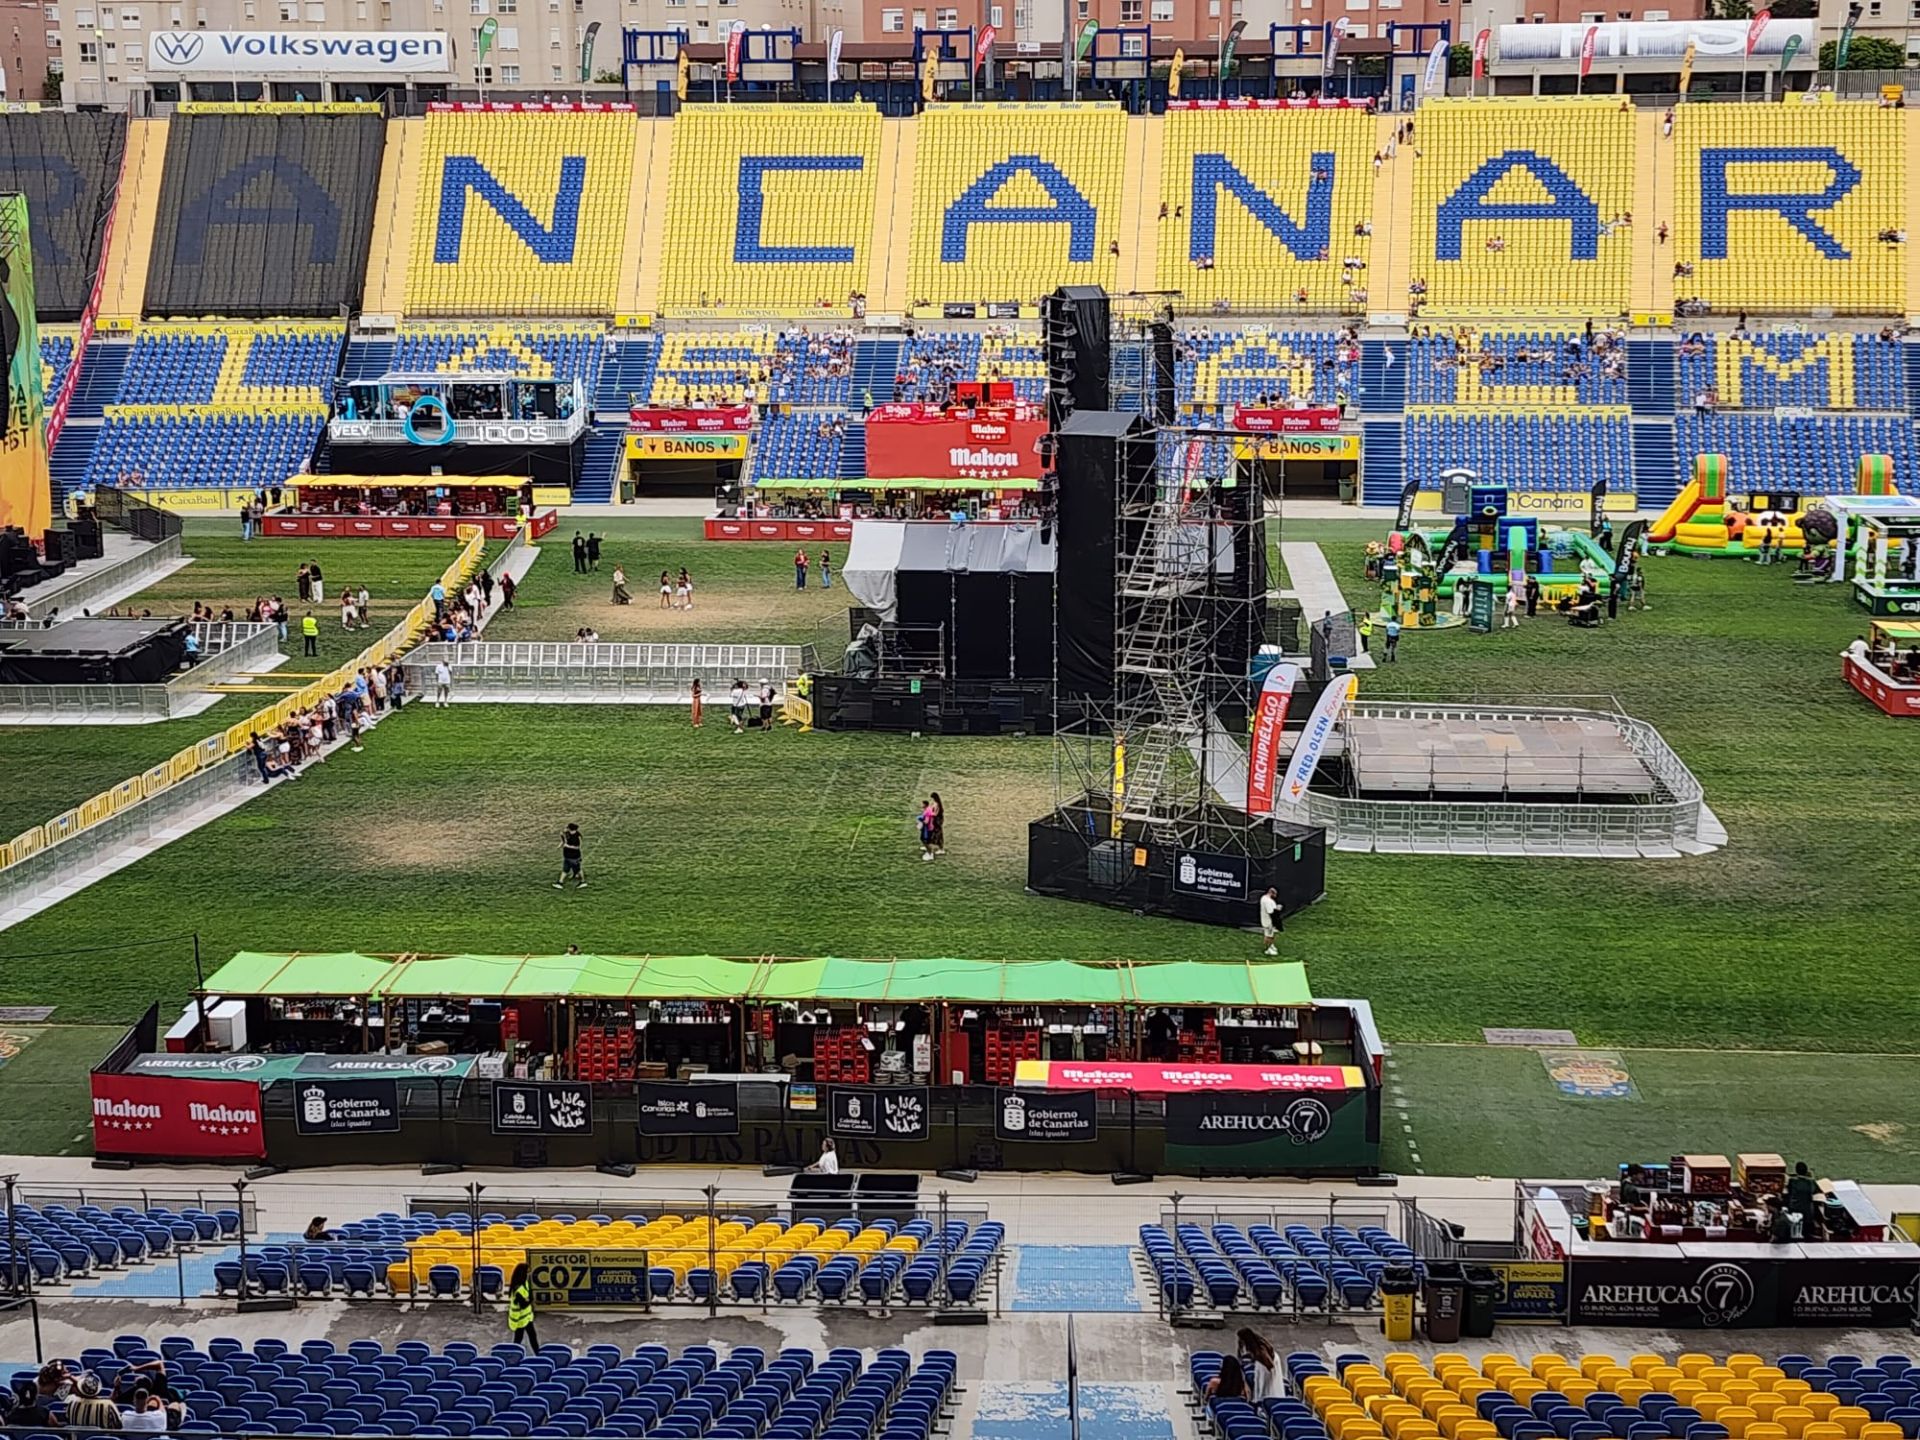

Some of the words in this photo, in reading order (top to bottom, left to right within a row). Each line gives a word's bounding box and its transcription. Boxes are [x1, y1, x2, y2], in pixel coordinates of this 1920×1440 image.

[219, 34, 442, 62] Volkswagen
[402, 323, 426, 331] HPS
[435, 323, 459, 331] HPS
[470, 323, 494, 331] HPS
[507, 323, 531, 331] HPS
[539, 323, 564, 331] HPS
[574, 323, 598, 331] HPS
[333, 426, 369, 436] VEEV
[479, 426, 548, 442] IQOS
[971, 423, 1006, 434] Mahou
[664, 437, 715, 453] BAÑOS
[949, 448, 1018, 467] Mahou
[169, 495, 218, 505] CaixaBank
[1518, 494, 1584, 508] Canaria
[1400, 495, 1414, 526] Bounty
[1619, 537, 1637, 572] Bounty
[1276, 695, 1289, 725] renting
[1253, 695, 1278, 792] ARCHIPIÉLAGO
[1197, 868, 1234, 879] Gobierno
[1207, 877, 1241, 887] Canarias
[139, 1059, 225, 1069] AREHUCAS
[330, 1061, 418, 1070] AREHUCAS
[1062, 1068, 1133, 1081] Mahou
[1161, 1070, 1232, 1082] Mahou
[1260, 1071, 1333, 1084] Mahou
[93, 1097, 161, 1118] Mahou
[329, 1099, 379, 1109] Gobierno
[189, 1103, 257, 1123] Mahou
[329, 1109, 343, 1118] de
[346, 1109, 391, 1118] Canarias
[1028, 1109, 1079, 1119] Gobierno
[550, 1111, 585, 1128] Vida
[885, 1116, 921, 1132] Vida
[1028, 1119, 1040, 1128] de
[1043, 1119, 1089, 1129] Canarias
[1199, 1114, 1291, 1130] AREHUCAS
[1299, 1111, 1315, 1132] 7
[541, 1255, 587, 1264] SECTOR
[532, 1266, 590, 1288] C07
[1581, 1285, 1702, 1304] AREHUCAS
[1715, 1281, 1734, 1309] 7
[1794, 1285, 1915, 1304] AREHUCAS
